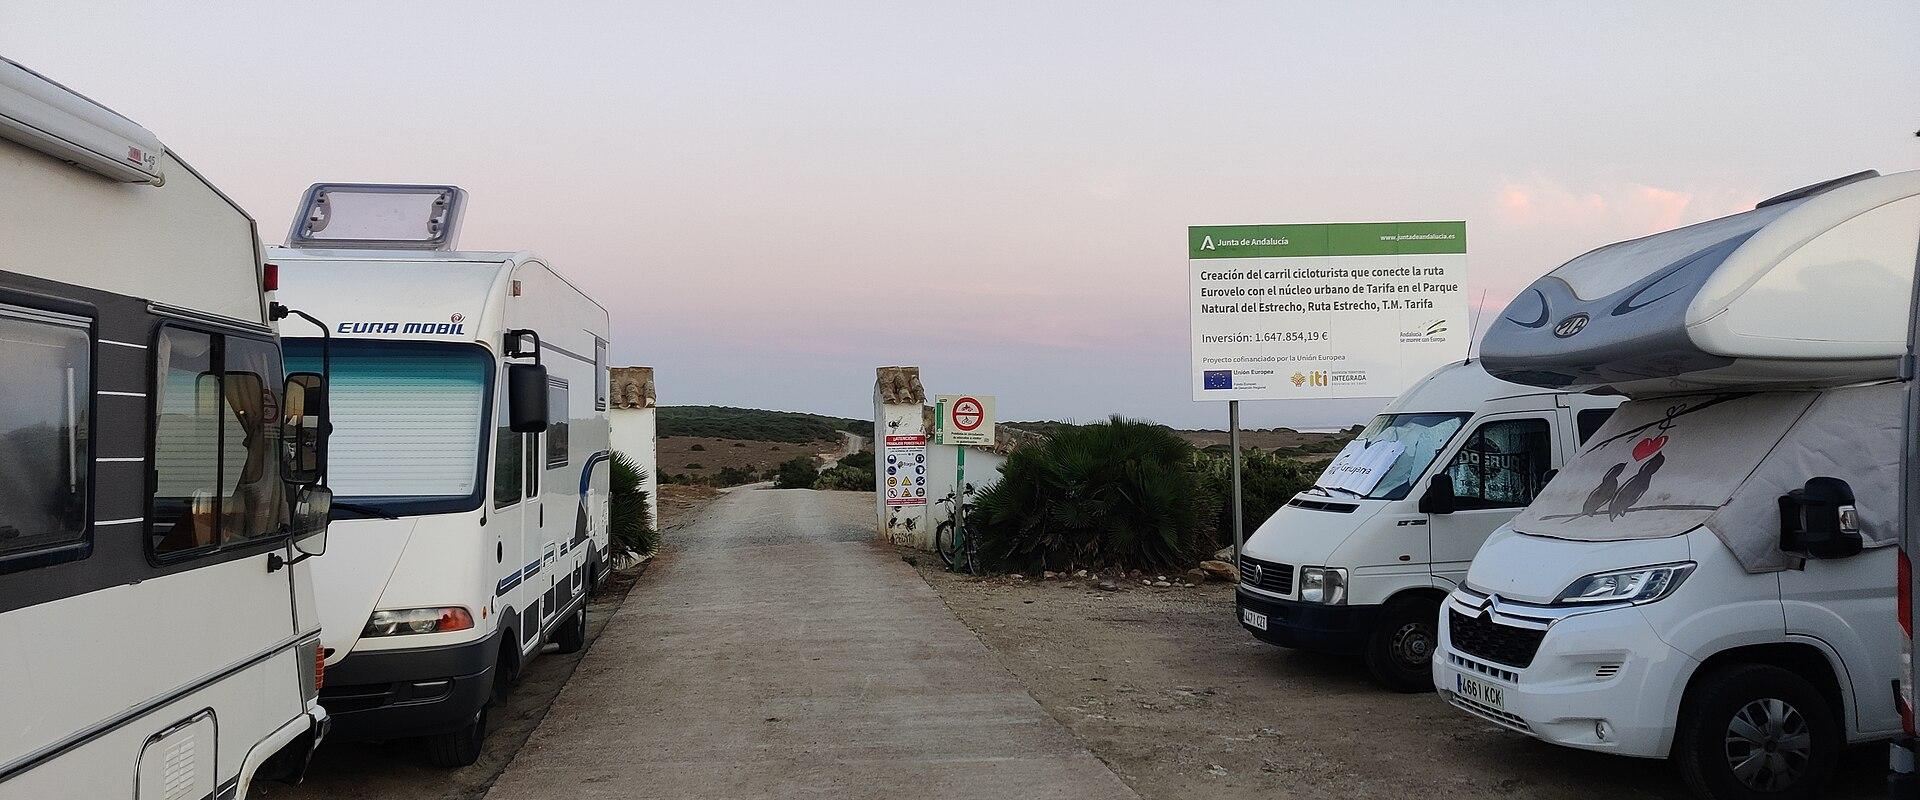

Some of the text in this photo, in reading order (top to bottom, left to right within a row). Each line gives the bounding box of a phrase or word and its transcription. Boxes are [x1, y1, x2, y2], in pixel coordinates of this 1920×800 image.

[1251, 237, 1288, 246] Andalucía
[1380, 233, 1456, 241] www.juntadeandalucia.es
[1200, 266, 1444, 280] Creación del carril cicloturista que conecte la ruta
[1201, 287, 1245, 297] Eurovelo
[1267, 286, 1276, 296] el
[1279, 284, 1312, 295] núcleo
[1314, 284, 1350, 294] urbano
[1352, 284, 1364, 294] de
[1366, 282, 1395, 293] Tarifa
[1397, 284, 1409, 292] en
[1412, 282, 1421, 292] el
[1423, 283, 1458, 294] Parque
[1201, 299, 1433, 313] Natural del Estrecho, Ruta Estrecho, T.M. Tarifa
[337, 322, 465, 335] EURA MOBIL
[1202, 331, 1328, 343] Inversión: 1.647.854,19 €
[1309, 370, 1328, 387] iti
[1462, 678, 1502, 706] 4661 KCK
